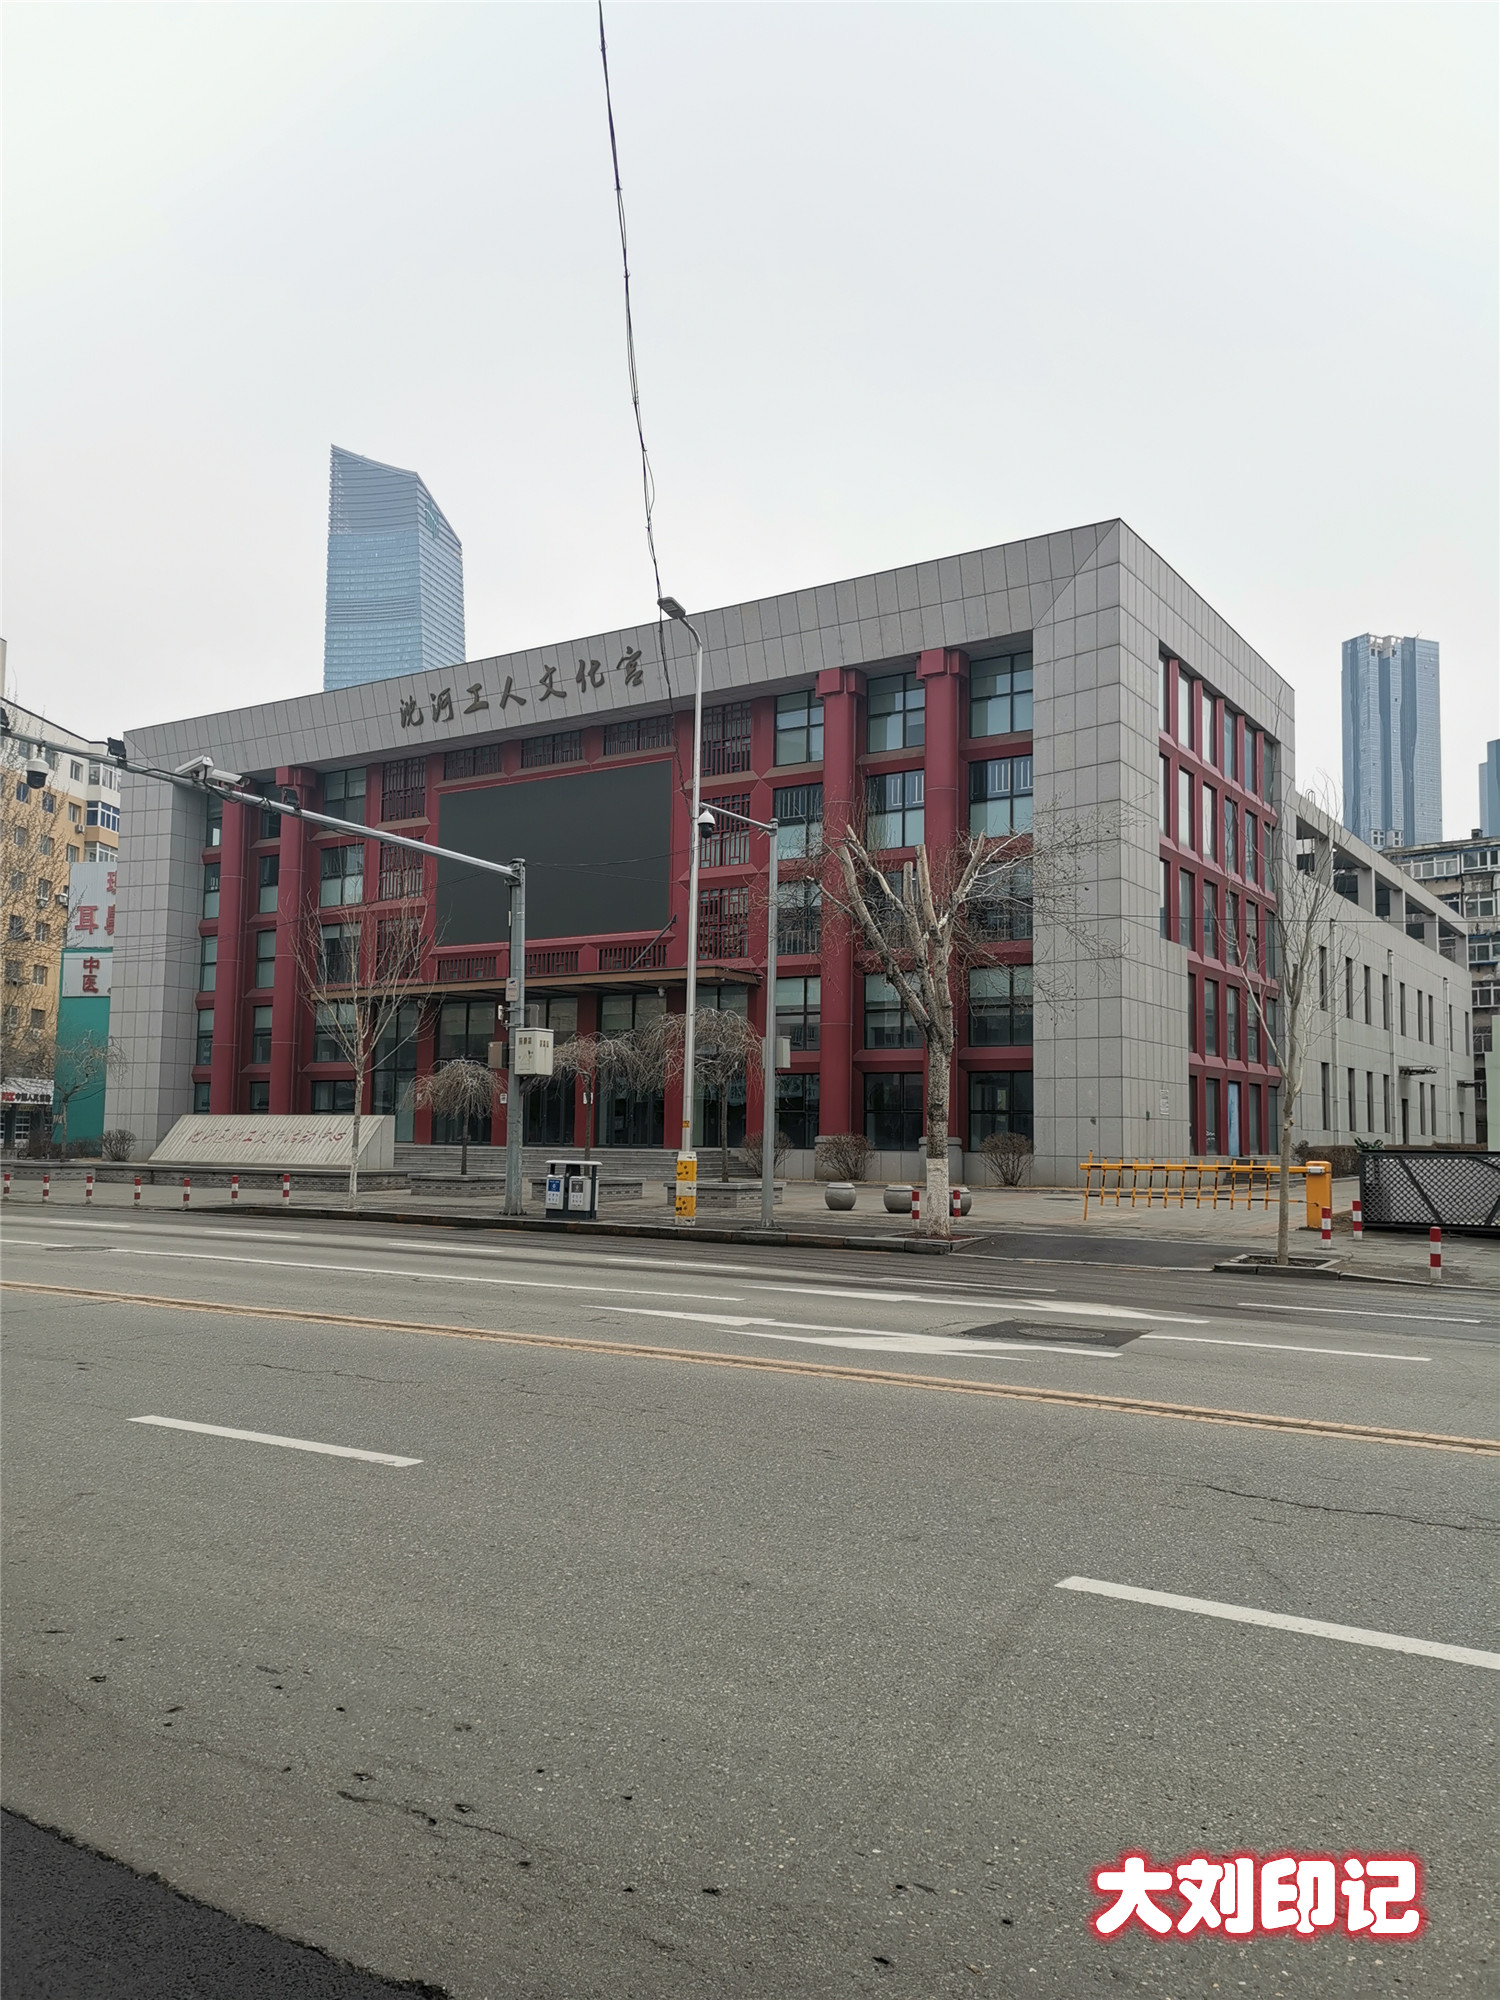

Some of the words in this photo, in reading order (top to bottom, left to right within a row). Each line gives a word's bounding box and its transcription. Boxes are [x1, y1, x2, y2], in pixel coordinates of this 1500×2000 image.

[400, 645, 643, 729] 沈河工人文化宫
[83, 956, 100, 994] 中医
